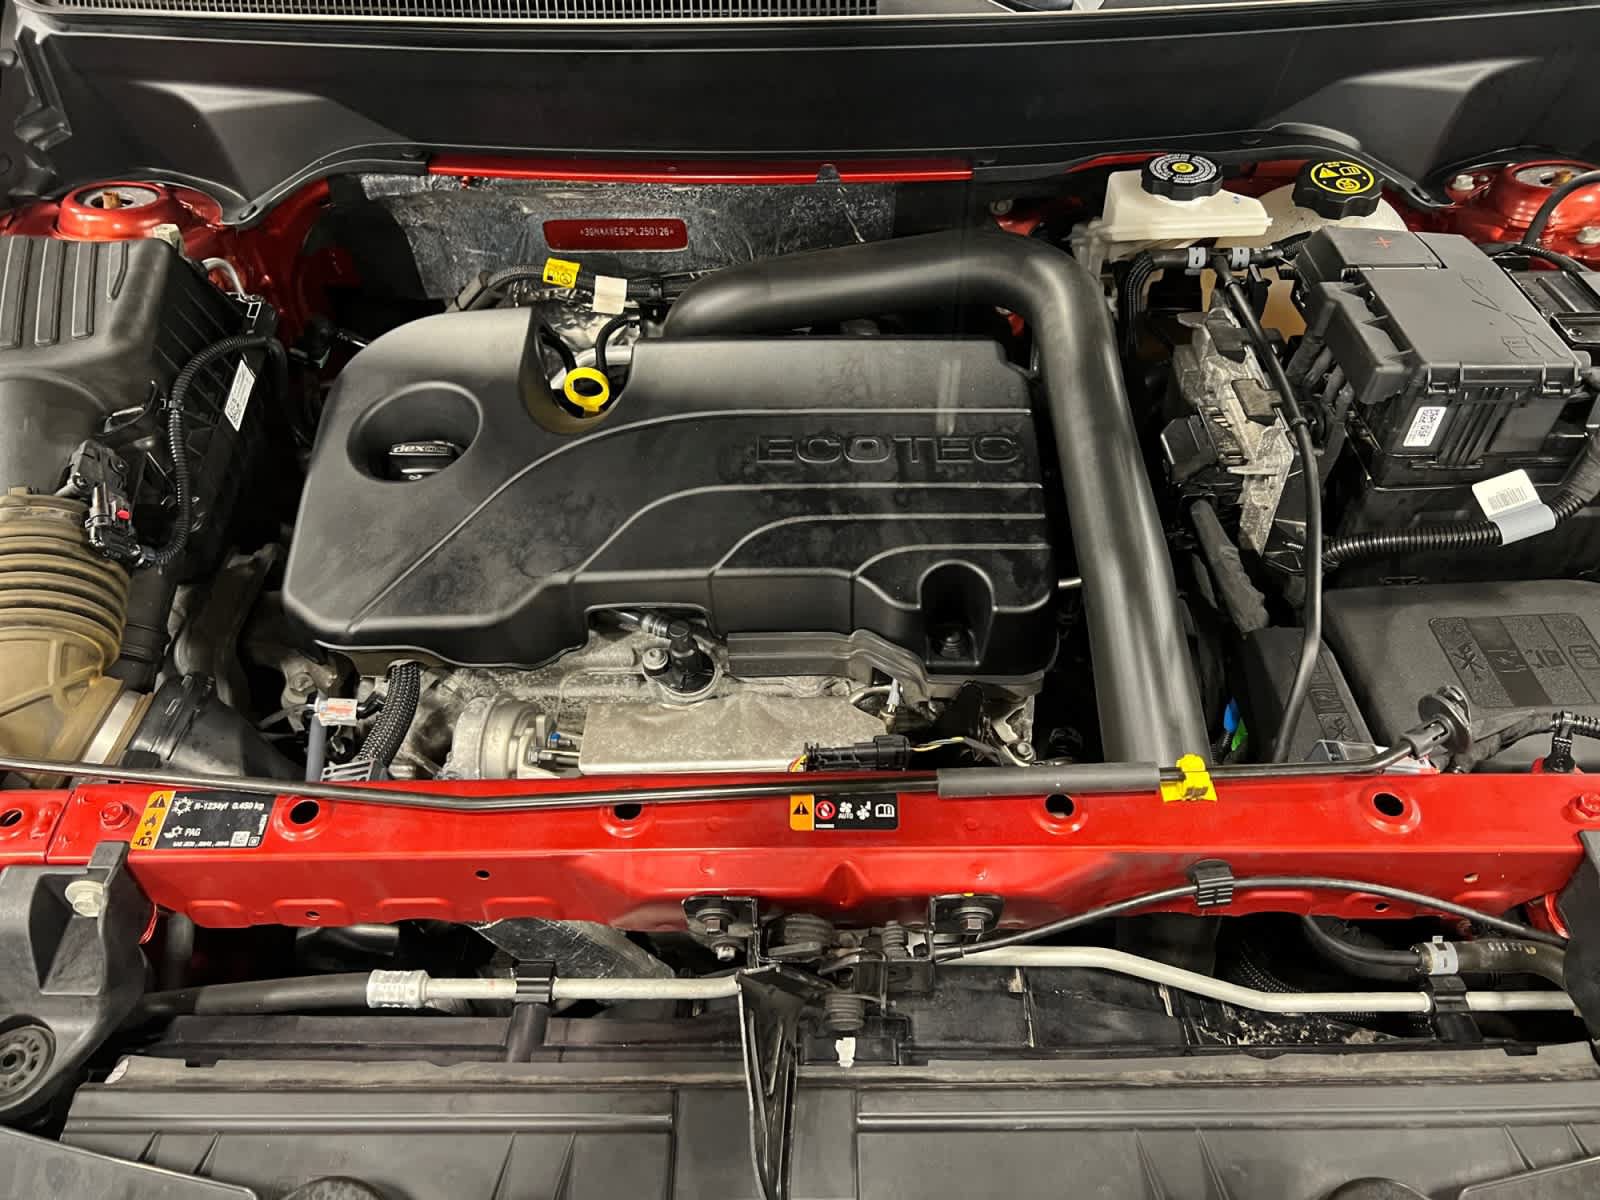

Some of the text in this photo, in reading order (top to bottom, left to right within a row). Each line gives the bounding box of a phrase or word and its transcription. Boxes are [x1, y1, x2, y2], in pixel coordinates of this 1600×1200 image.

[756, 437, 1017, 463] ECOTEC
[254, 801, 265, 811] kg
[184, 827, 201, 837] PAG
